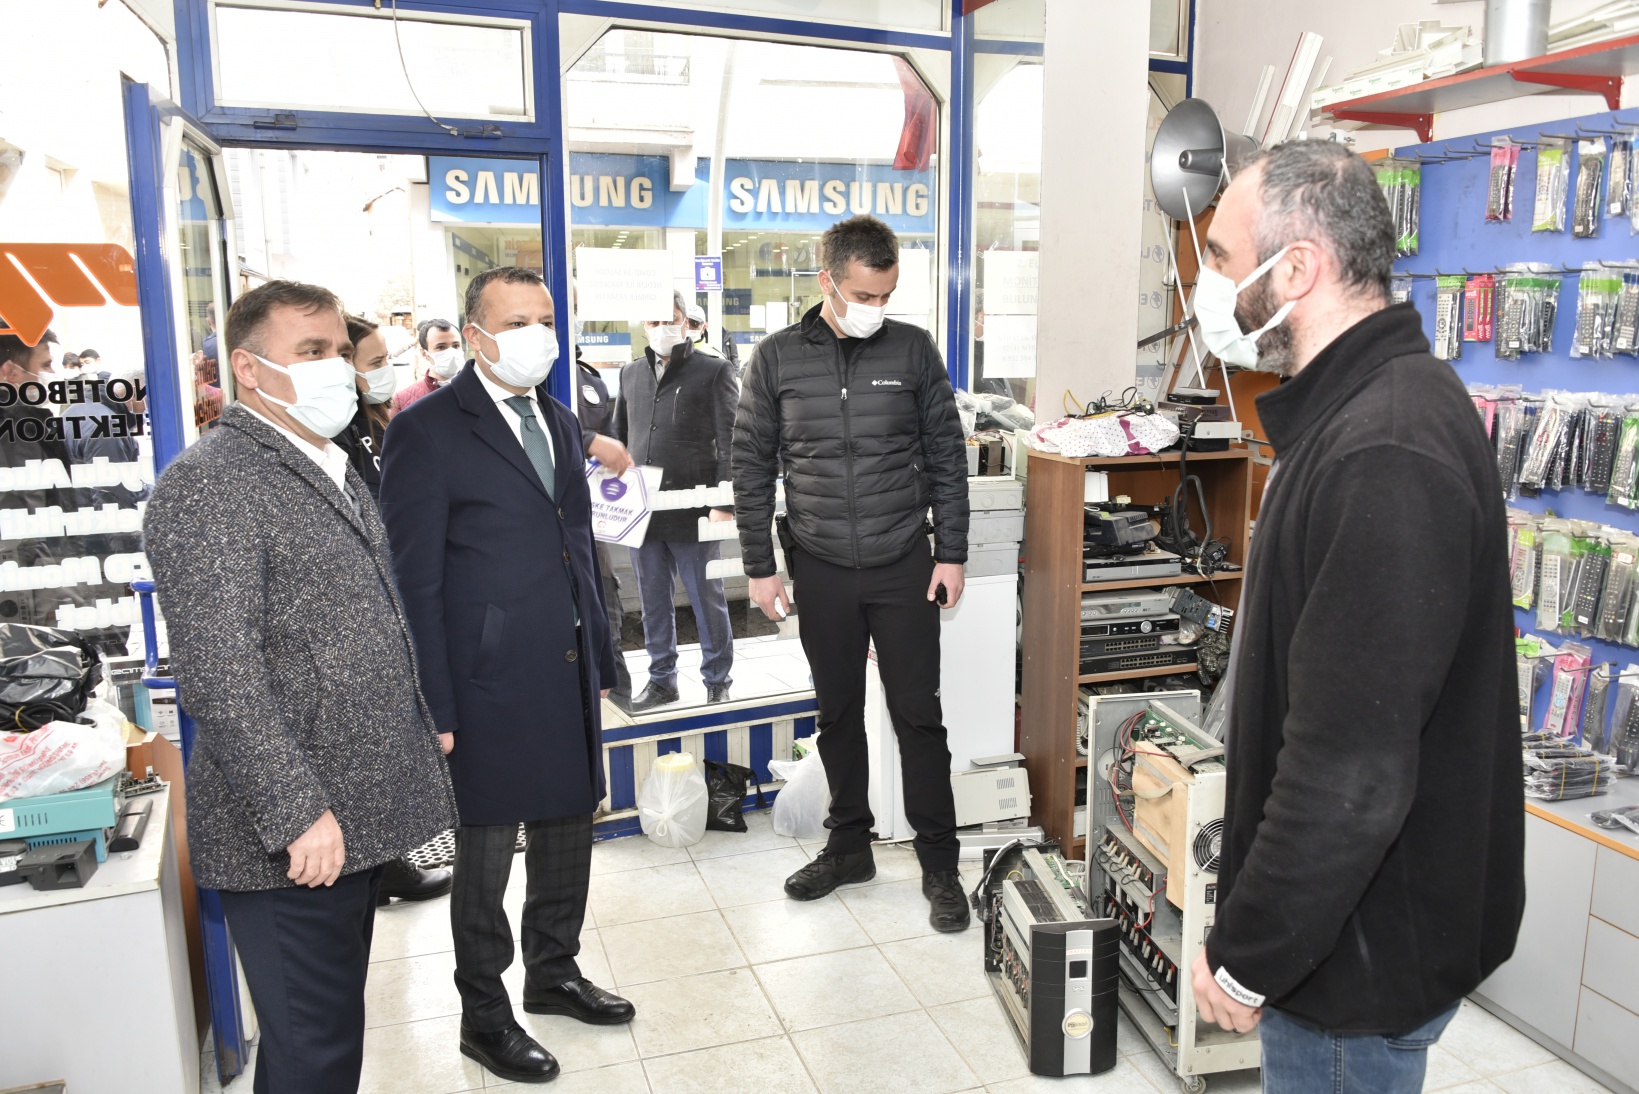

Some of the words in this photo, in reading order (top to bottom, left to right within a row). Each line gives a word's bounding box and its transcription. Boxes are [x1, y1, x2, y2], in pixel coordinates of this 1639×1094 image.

[445, 169, 653, 209] SAMUNG
[729, 176, 929, 217] SAMSUNG
[1002, 275, 1039, 286] MONİT
[1002, 294, 1038, 304] BULUN
[577, 335, 609, 344] MSUNG
[591, 501, 605, 511] SKE
[606, 503, 634, 516] TAKMAK
[591, 512, 628, 524] RUNLUDUR
[1218, 974, 1258, 1004] uhlsport
